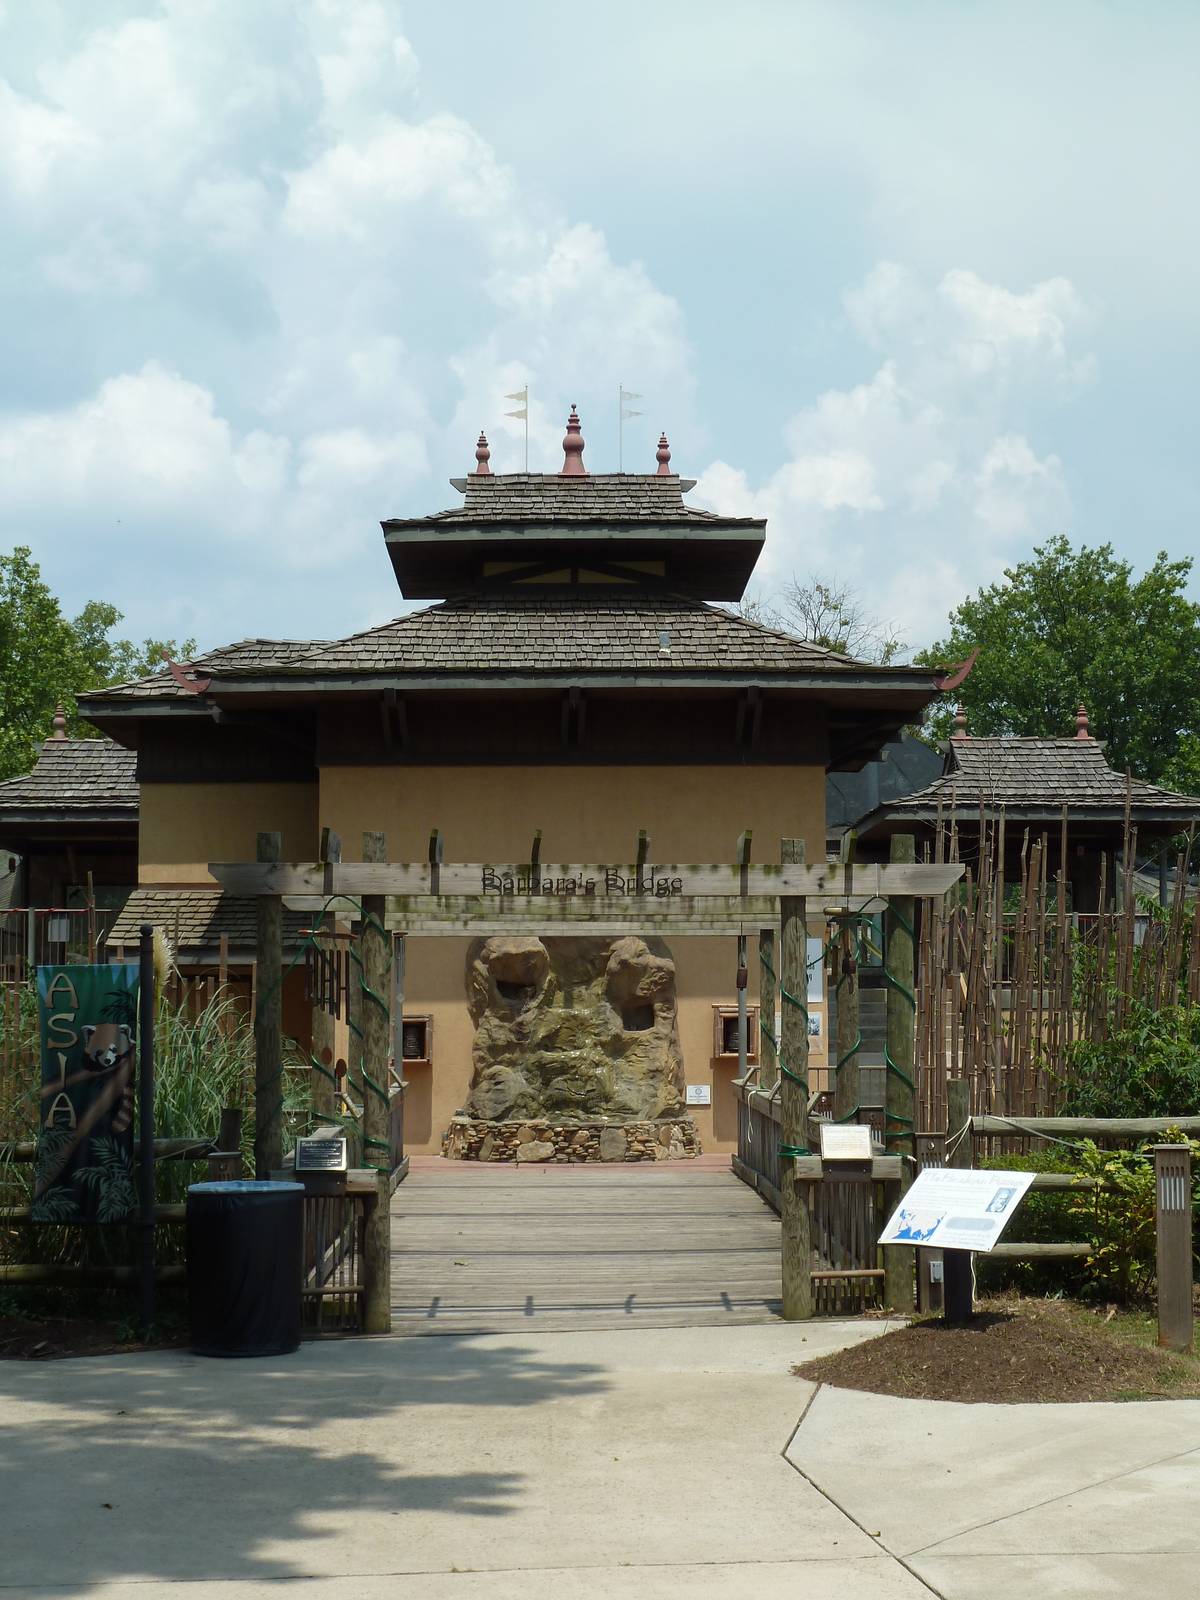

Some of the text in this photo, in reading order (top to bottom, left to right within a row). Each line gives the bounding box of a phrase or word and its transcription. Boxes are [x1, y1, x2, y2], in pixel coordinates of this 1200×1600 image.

[482, 867, 683, 895] Barbara's Bridge
[45, 972, 79, 1129] ASIA
